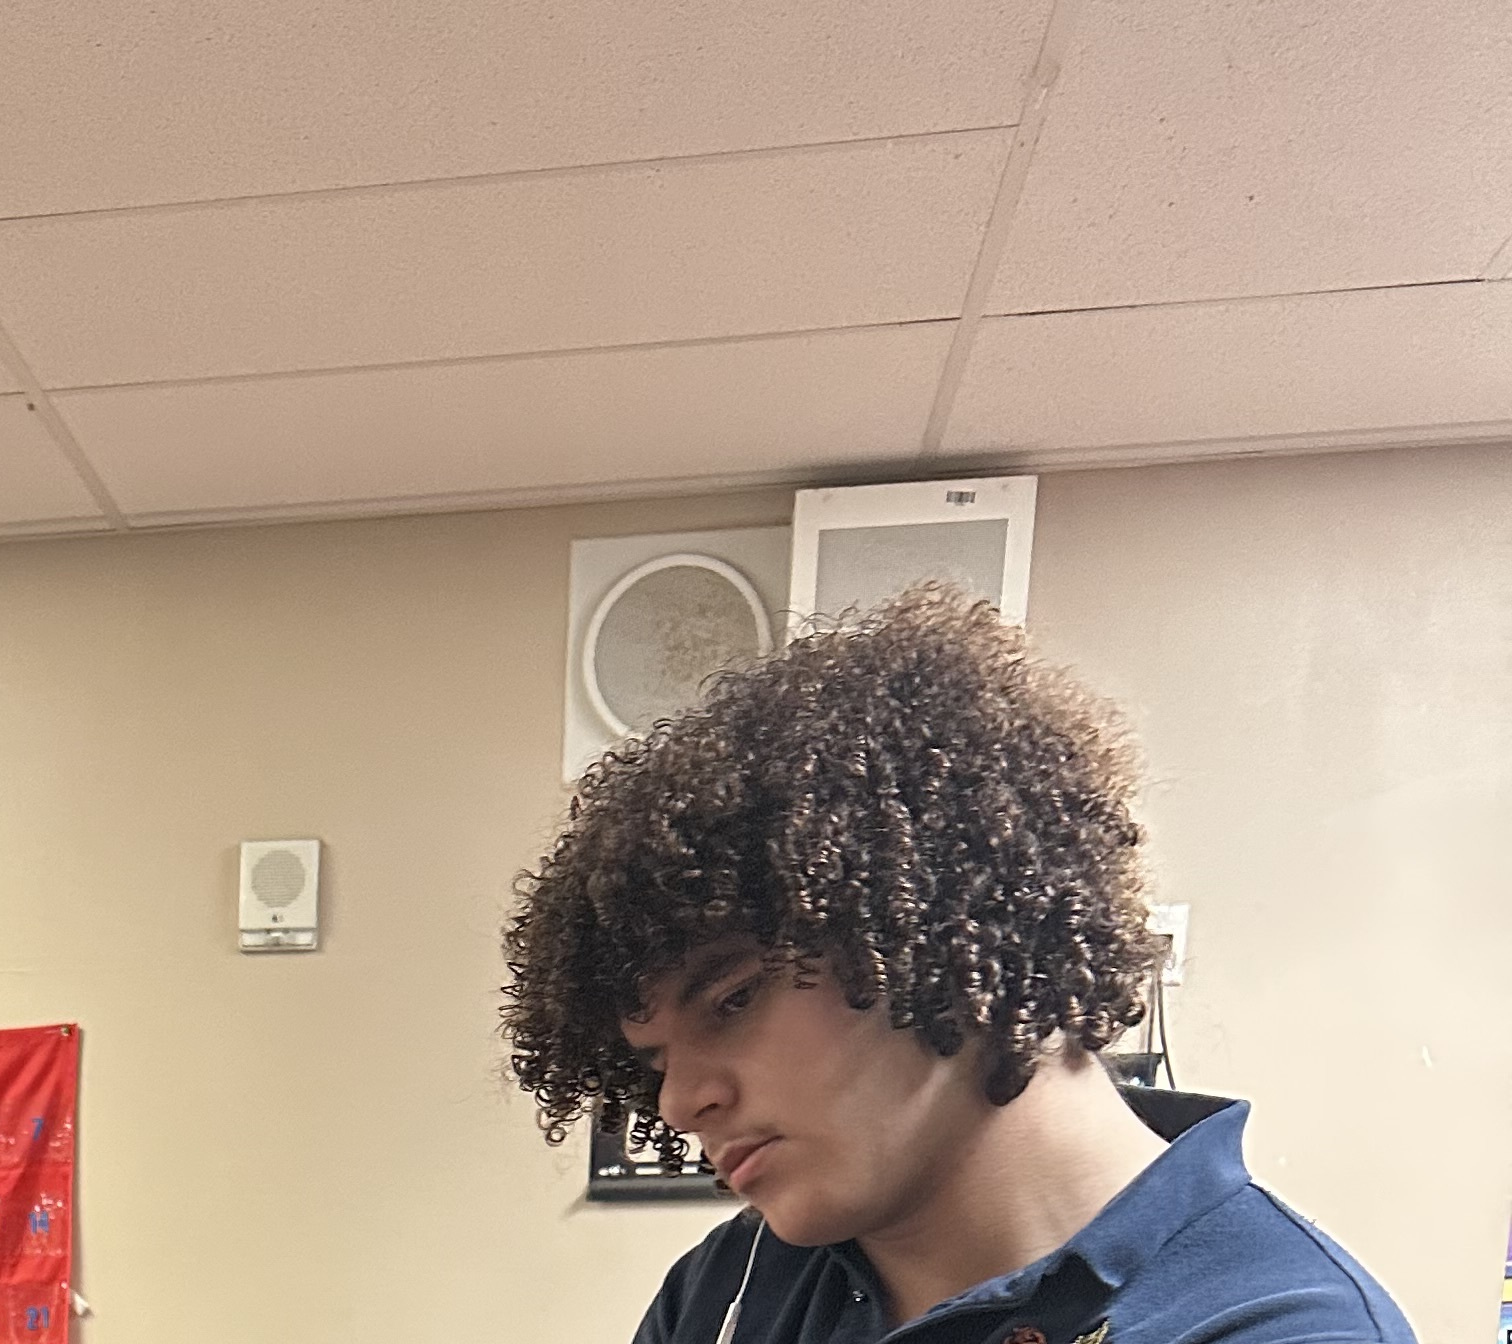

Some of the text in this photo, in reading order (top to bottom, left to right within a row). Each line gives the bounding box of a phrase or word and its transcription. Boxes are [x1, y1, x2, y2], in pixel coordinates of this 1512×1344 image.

[31, 1116, 44, 1141] 7
[29, 1210, 49, 1235] 14
[26, 1306, 50, 1331] 21
